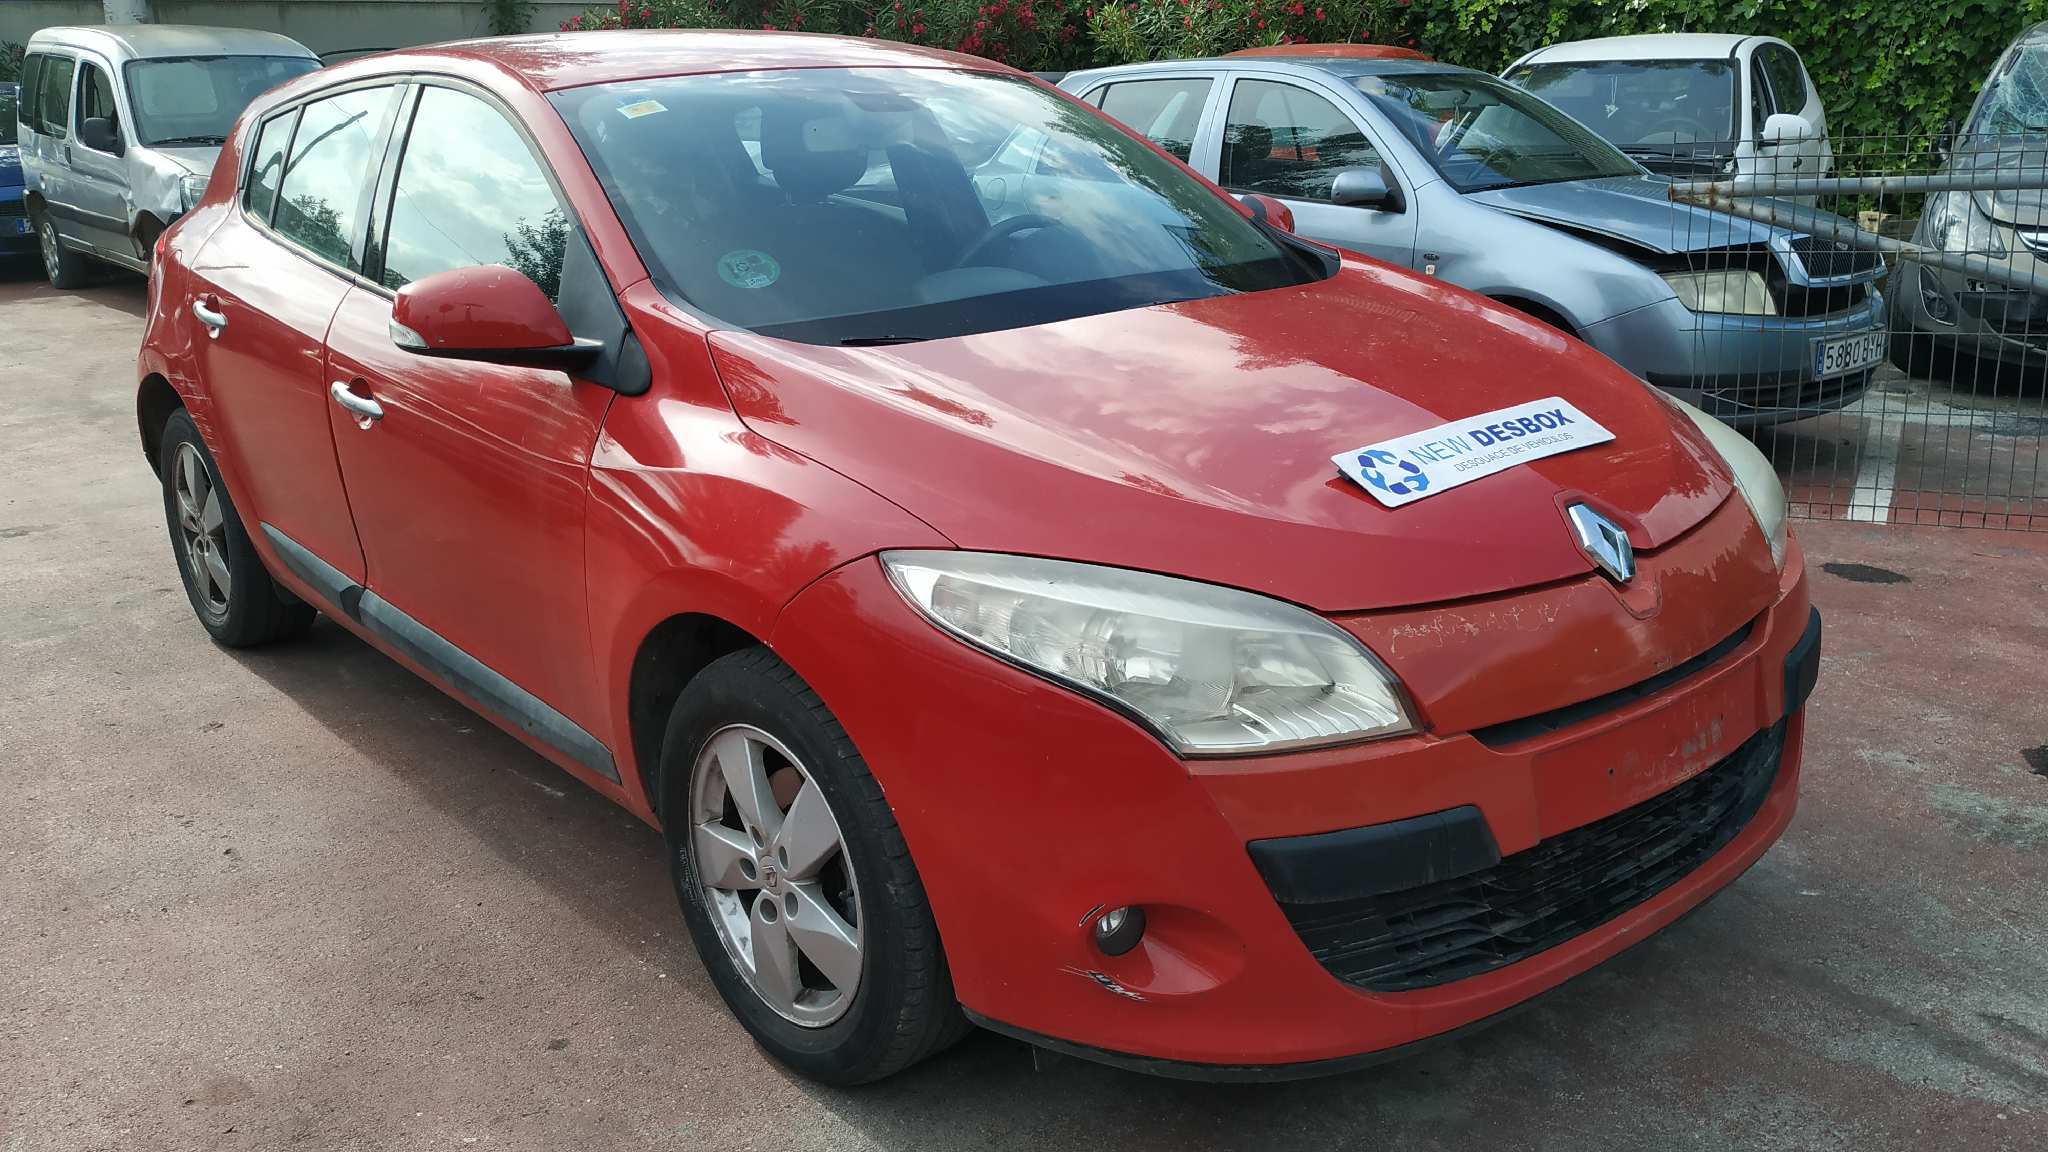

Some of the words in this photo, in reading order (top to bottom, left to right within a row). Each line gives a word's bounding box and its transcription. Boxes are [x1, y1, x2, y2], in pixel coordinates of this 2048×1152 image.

[1826, 340, 1859, 370] 5880
[1408, 435, 1472, 464] NEW
[1467, 408, 1575, 447] DESBOX
[1507, 444, 1523, 455] DE
